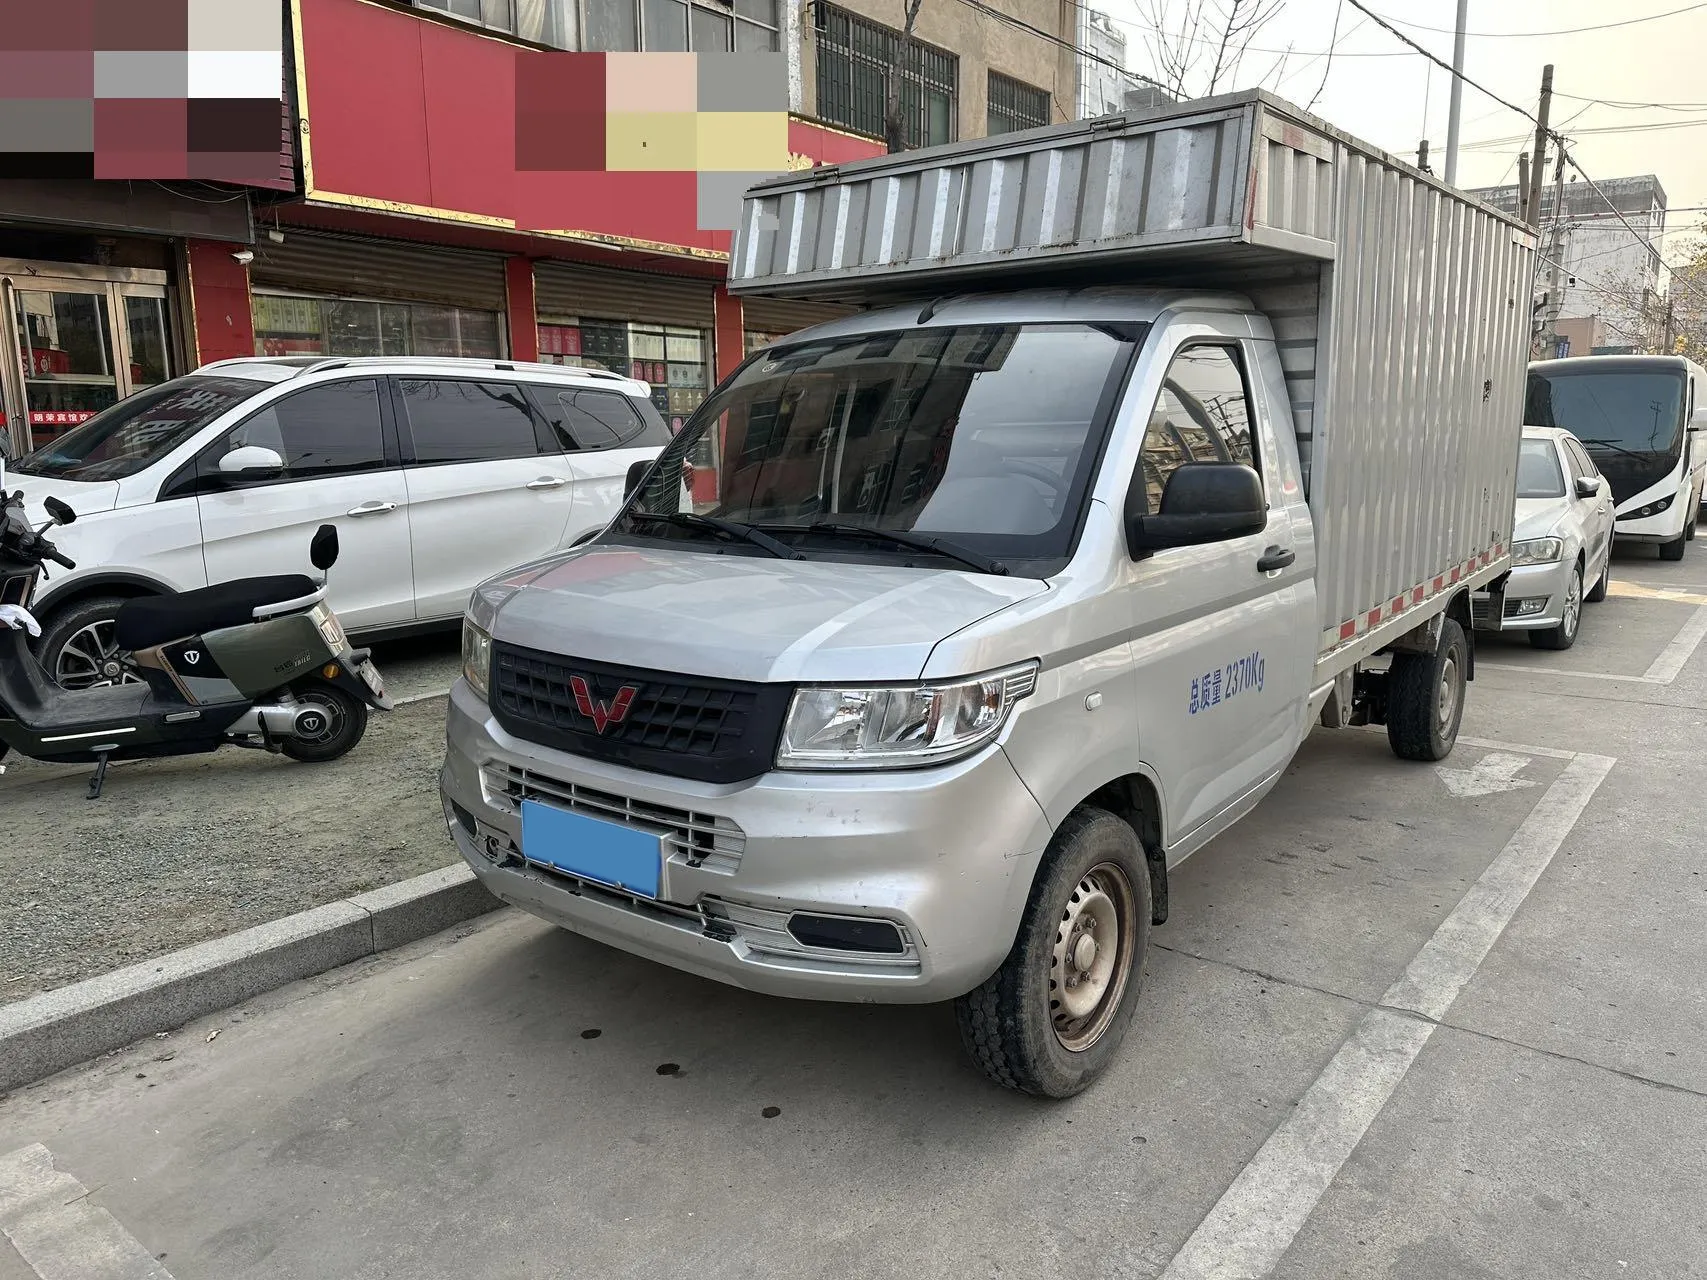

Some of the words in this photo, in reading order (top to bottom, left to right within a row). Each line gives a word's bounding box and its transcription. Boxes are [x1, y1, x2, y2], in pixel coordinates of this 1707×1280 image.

[1189, 669, 1222, 714] 总质量
[1225, 651, 1265, 699] 2370Kg
